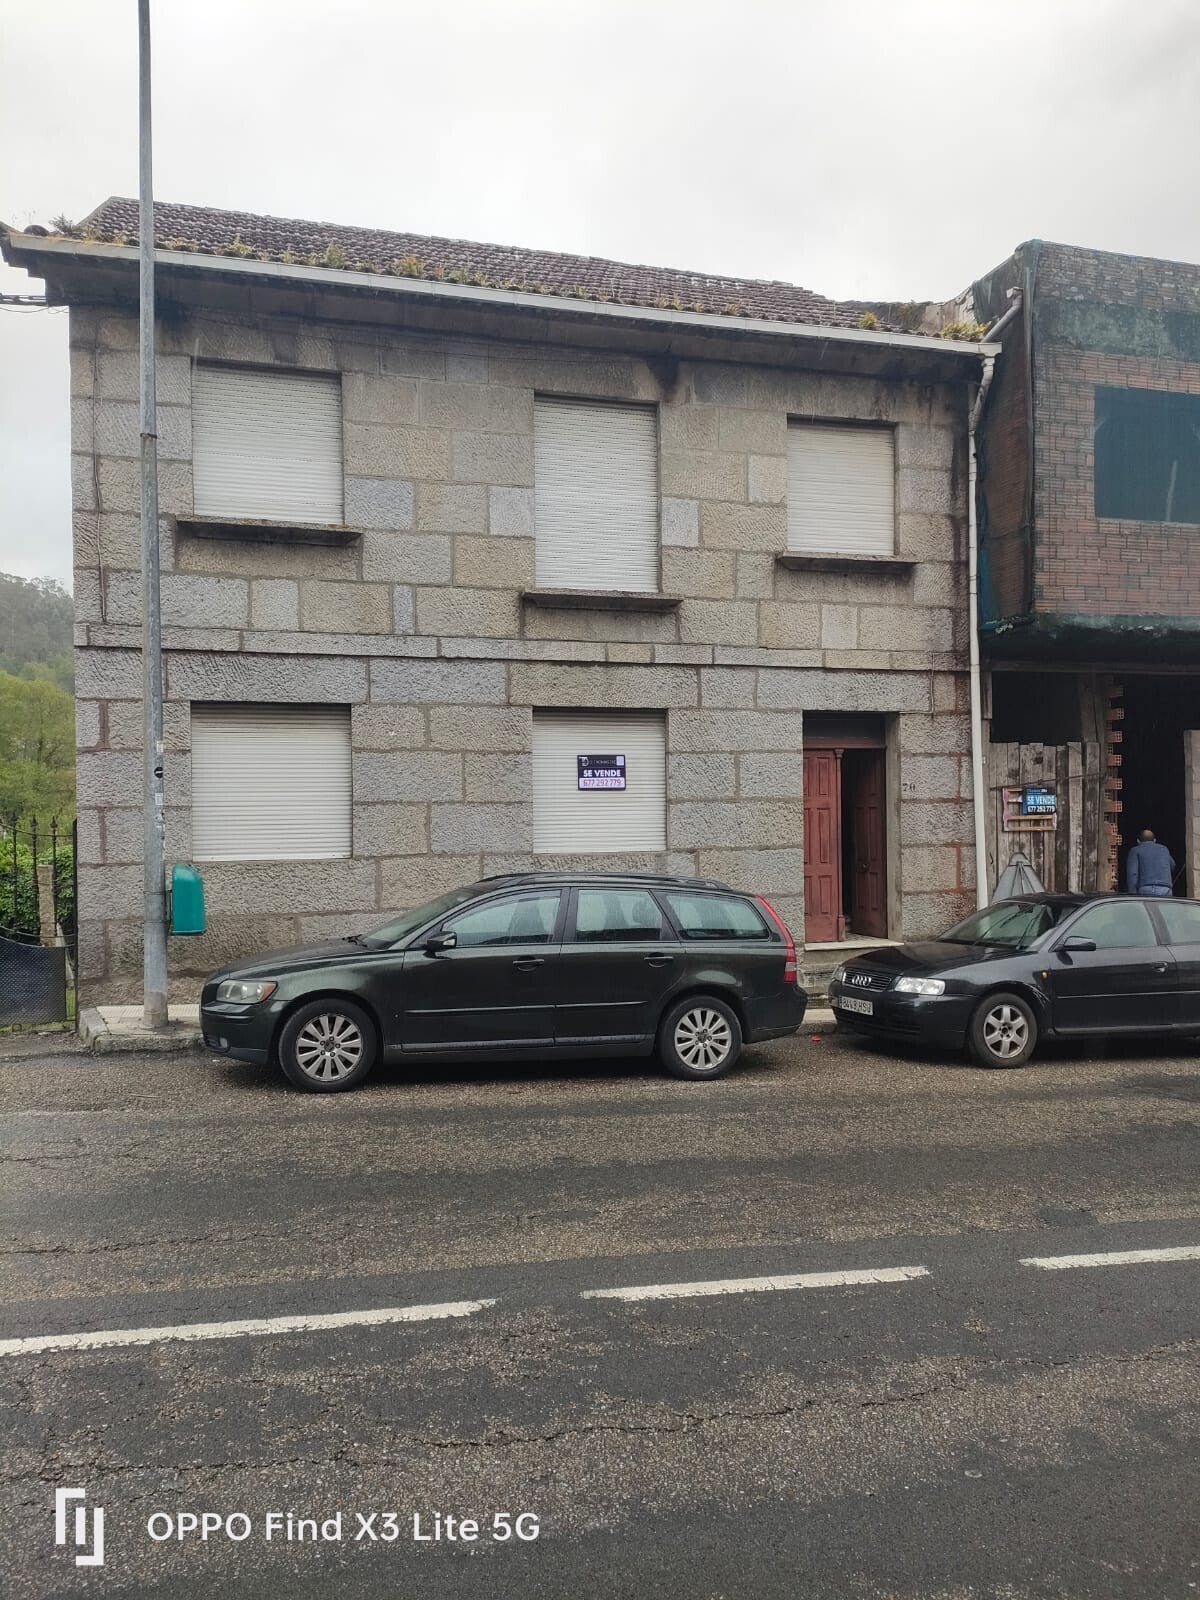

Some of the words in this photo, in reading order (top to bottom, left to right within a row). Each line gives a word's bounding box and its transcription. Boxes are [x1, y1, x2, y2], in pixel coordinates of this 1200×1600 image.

[583, 769, 593, 777] SE
[594, 769, 621, 777] VENDE
[1027, 795, 1035, 805] SE
[1036, 794, 1056, 805] VENDE
